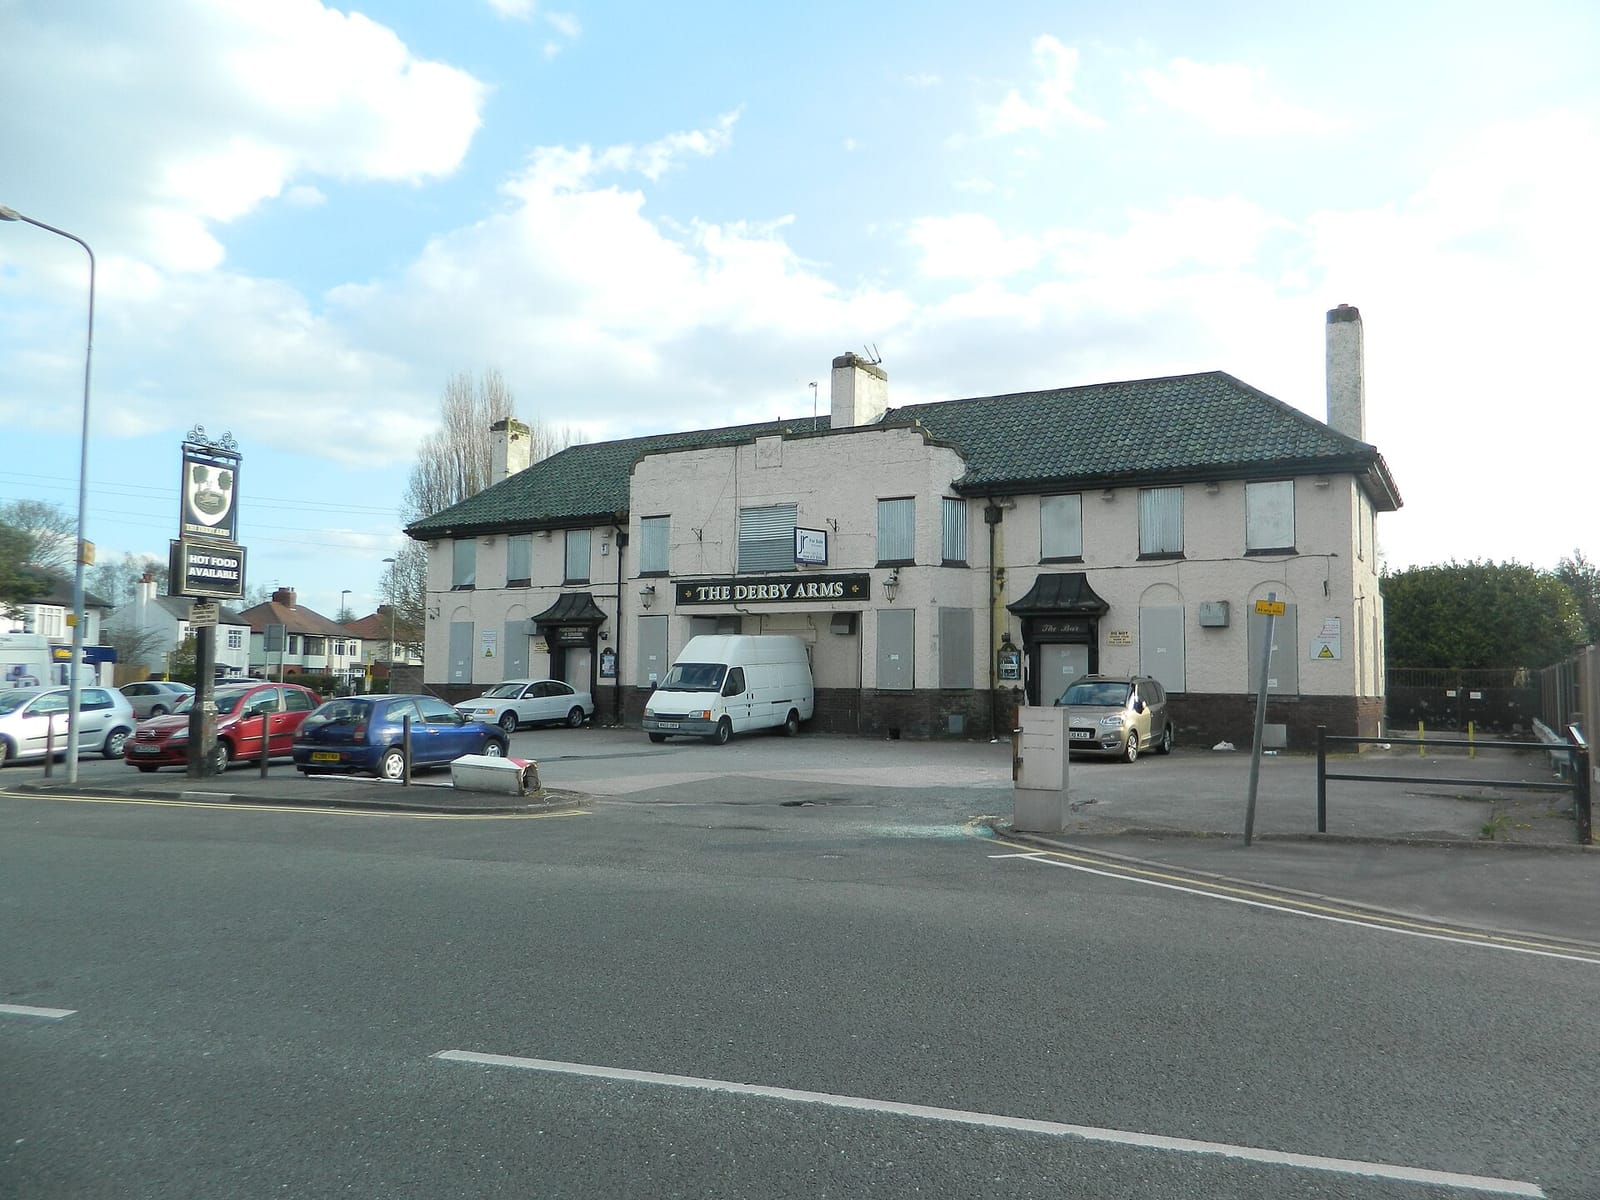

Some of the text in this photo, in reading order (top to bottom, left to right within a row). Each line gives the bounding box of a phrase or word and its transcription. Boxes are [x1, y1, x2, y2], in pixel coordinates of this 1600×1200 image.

[188, 554, 238, 568] HOT FOOD
[187, 566, 239, 580] AVAILABLE
[696, 581, 844, 600] THE DERBY ARMS
